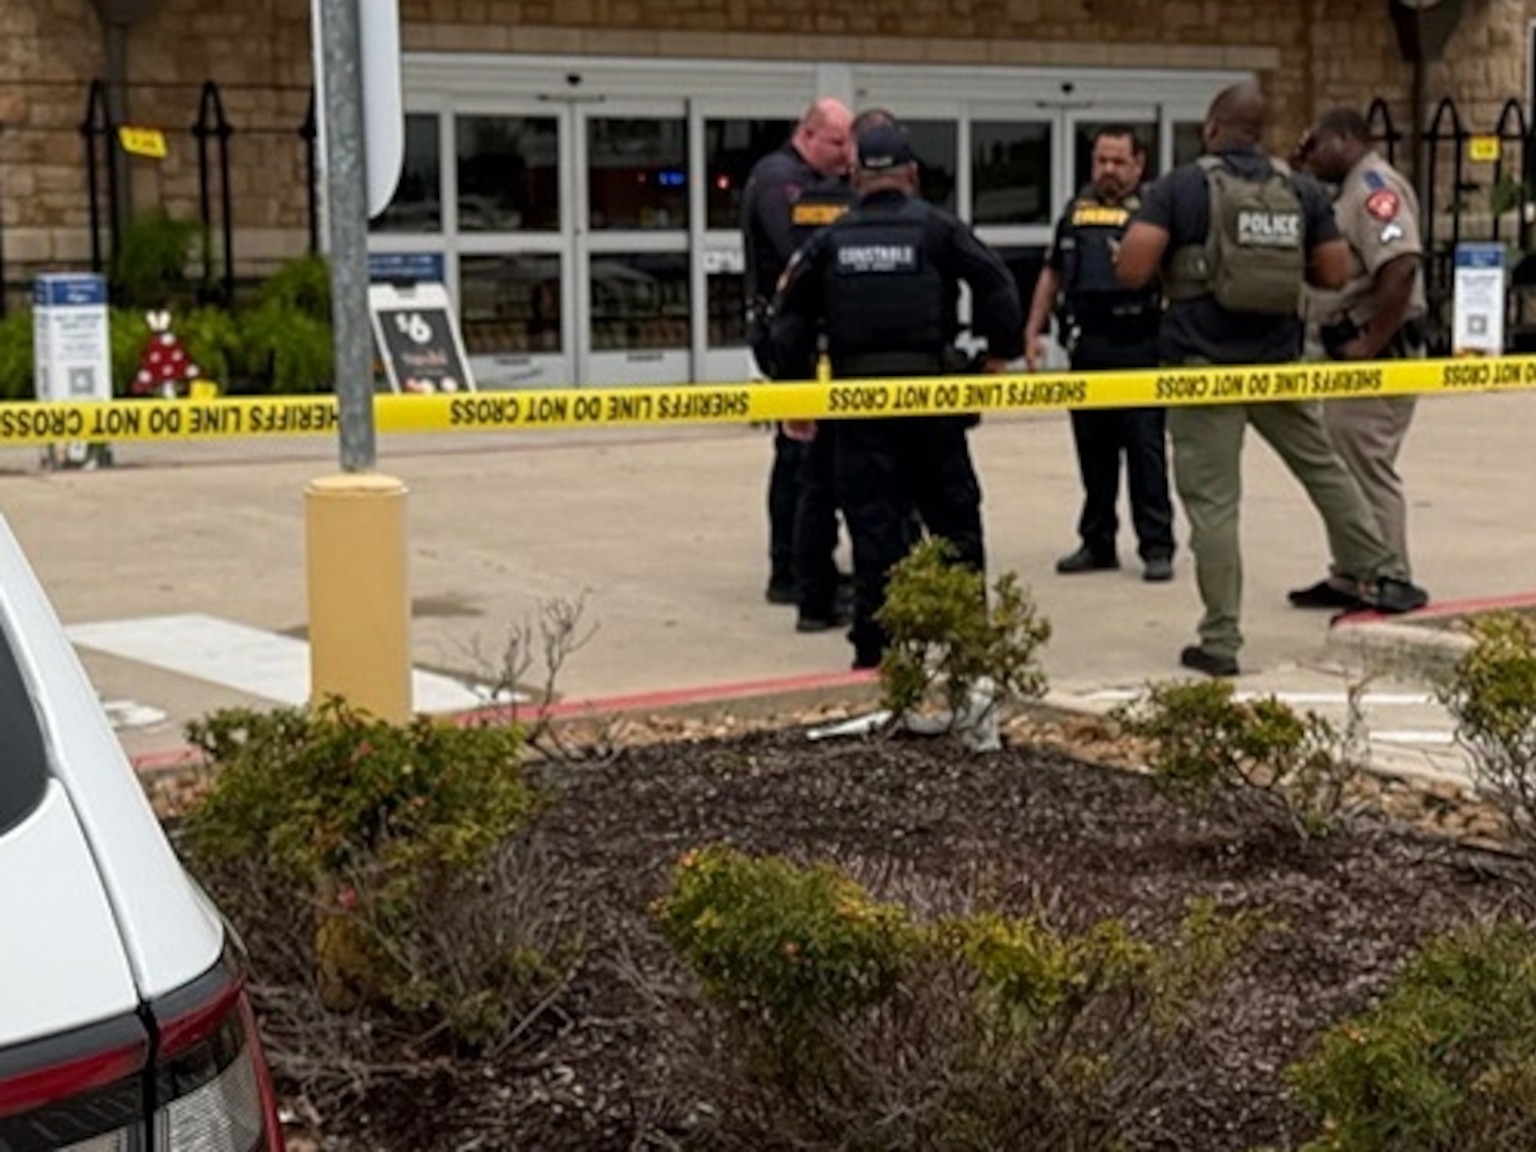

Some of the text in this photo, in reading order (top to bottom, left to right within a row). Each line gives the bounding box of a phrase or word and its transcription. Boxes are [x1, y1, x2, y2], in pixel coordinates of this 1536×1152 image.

[1238, 212, 1300, 235] POLICE
[827, 379, 1086, 410] SHERIFFS LINE DO NOT CROSS
[1155, 367, 1381, 397] SHERIFFS LINE DO NOT CROSS
[0, 402, 341, 436] HERIFFS LINE DO NOT CROSS
[450, 390, 751, 423] SHERIFFS LINE DO NOT CROSS
